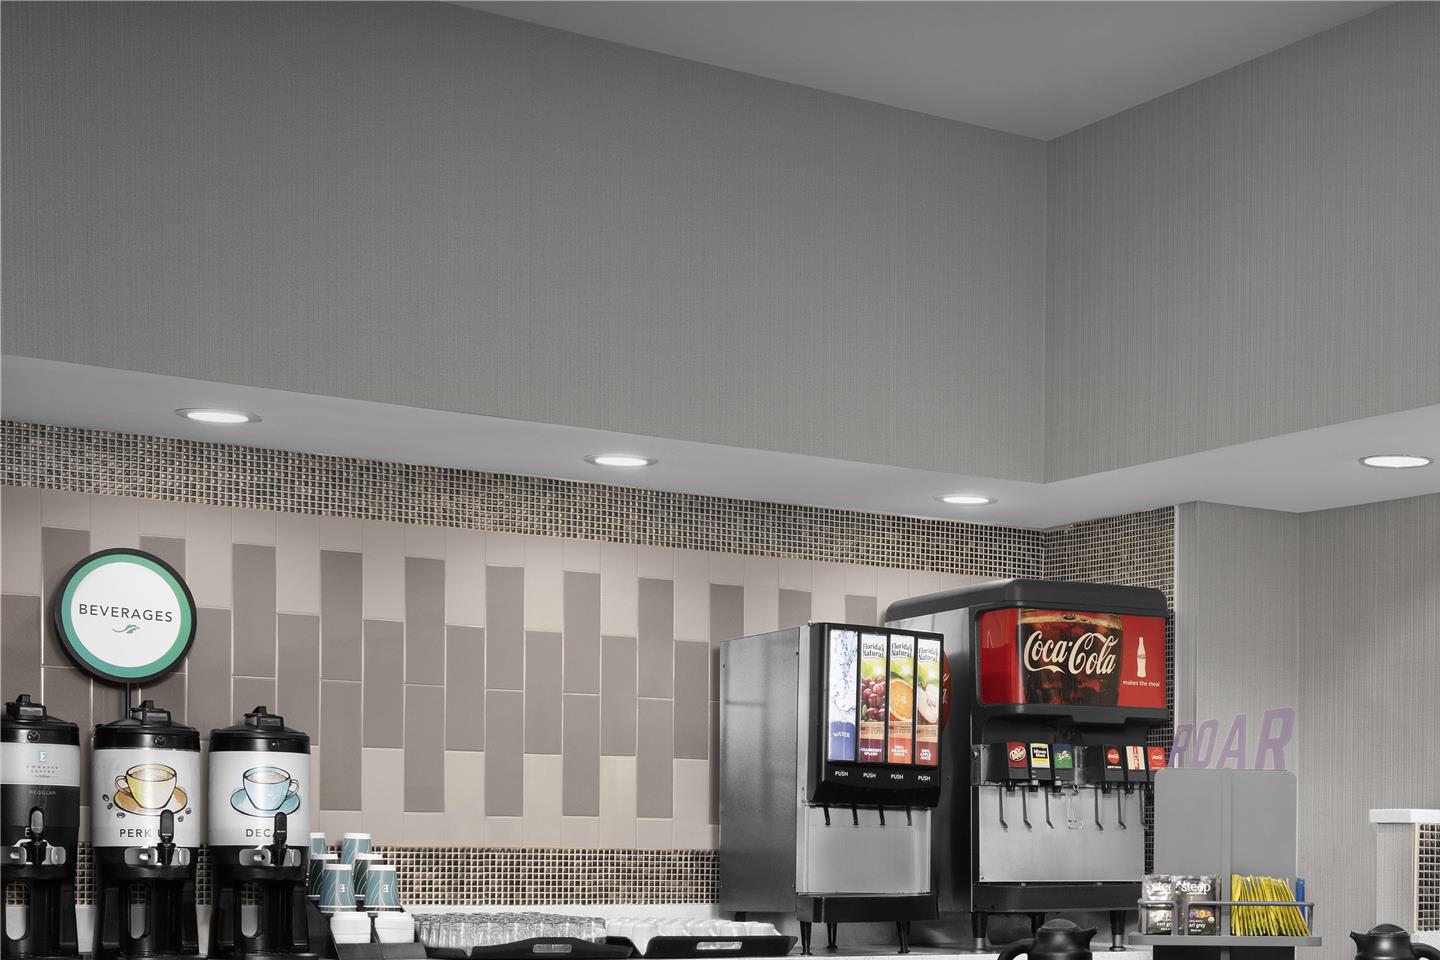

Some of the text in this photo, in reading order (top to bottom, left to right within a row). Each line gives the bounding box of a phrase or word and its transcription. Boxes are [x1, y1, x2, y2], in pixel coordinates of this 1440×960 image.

[79, 603, 173, 623] BEVERAGES
[1023, 630, 1119, 675] Coca-Cola
[119, 828, 152, 838] PERK
[245, 828, 276, 838] DEC
[1181, 881, 1211, 894] steep
